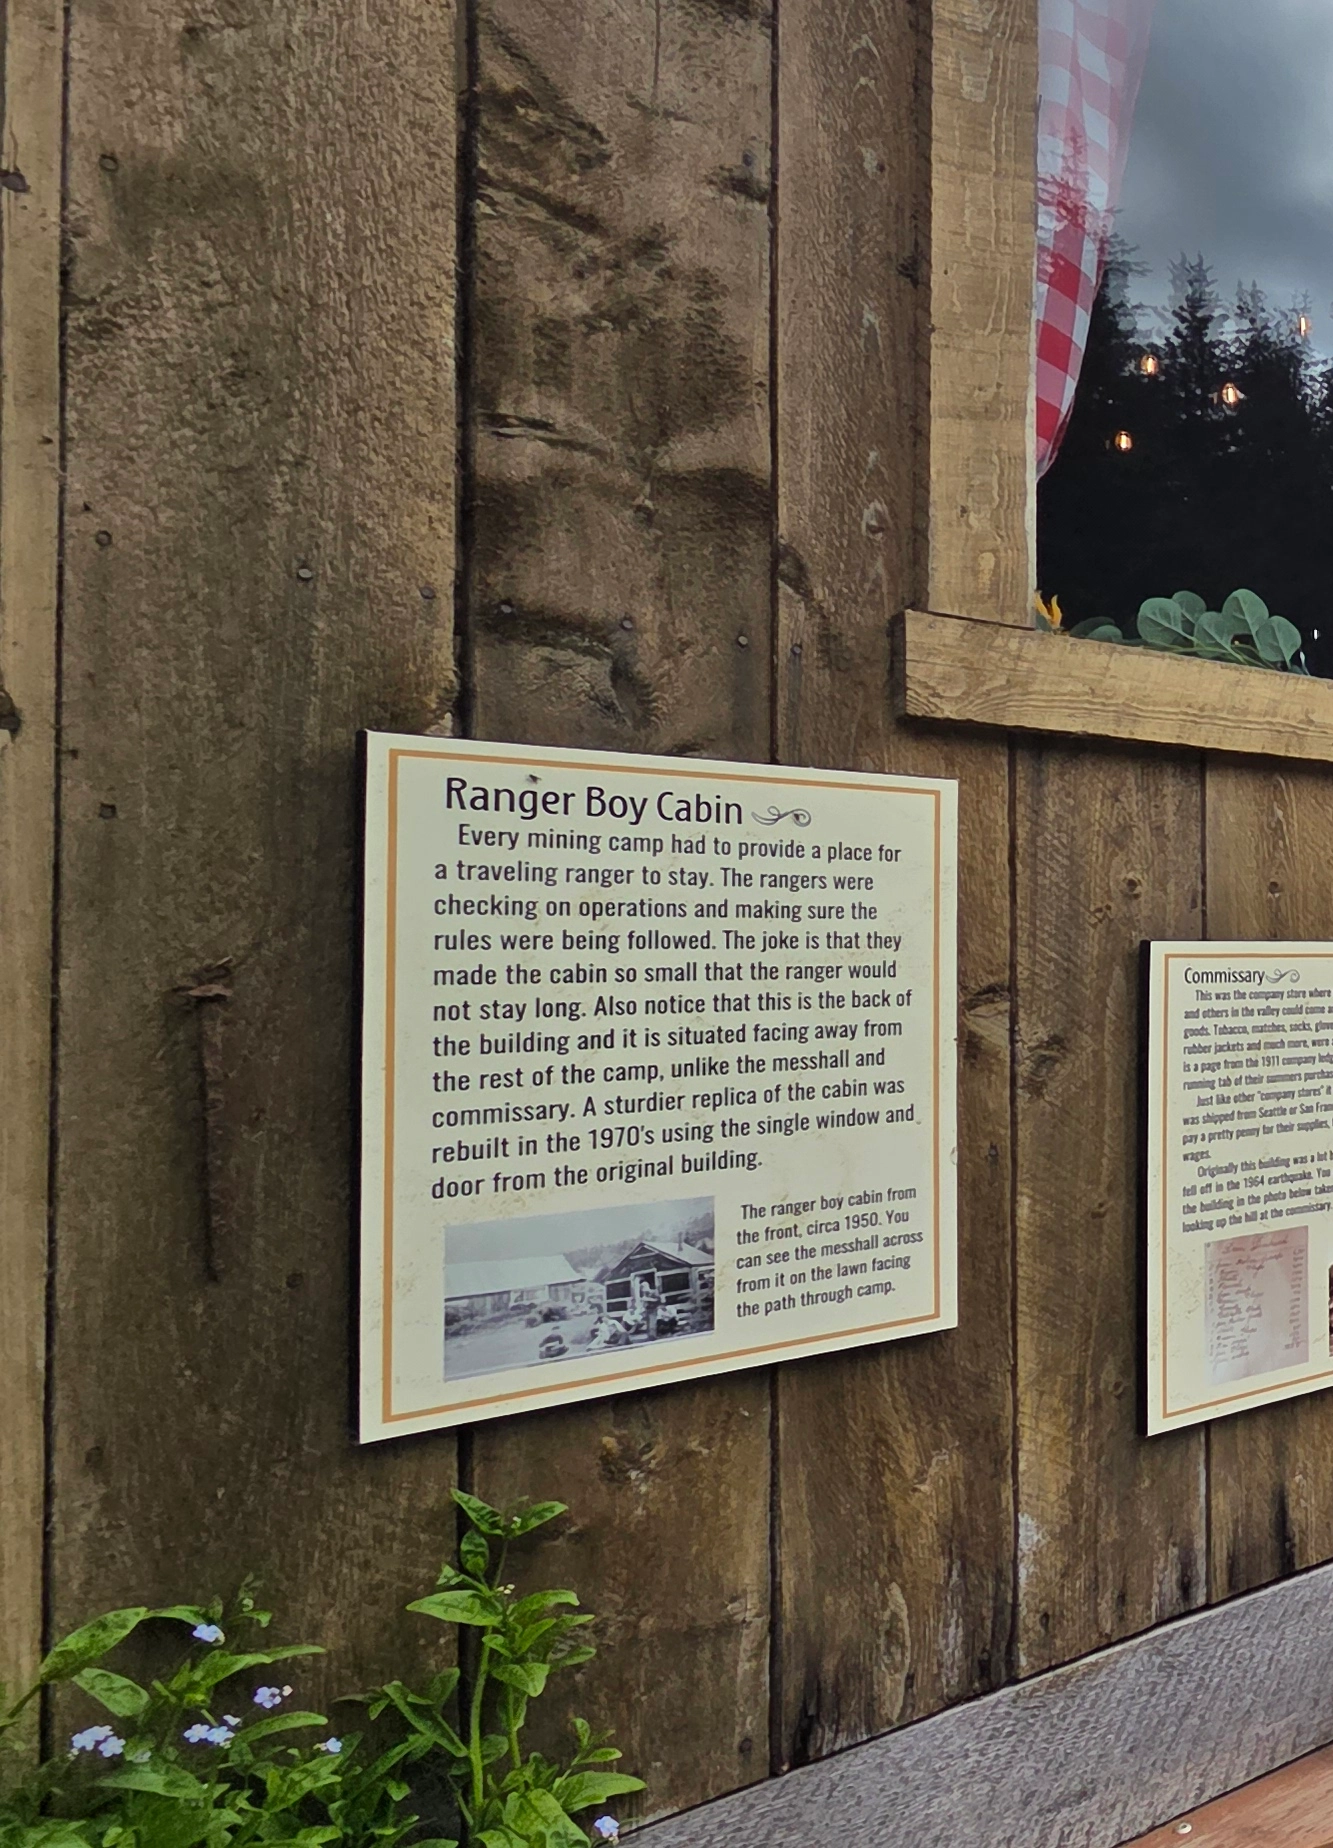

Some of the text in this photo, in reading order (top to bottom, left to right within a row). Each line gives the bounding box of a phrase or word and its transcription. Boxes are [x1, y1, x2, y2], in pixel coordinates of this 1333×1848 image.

[446, 777, 742, 825] Ranger Boy Cabin
[458, 823, 901, 863] Every mining camp had to provide a place for
[434, 860, 873, 892] a traveling ranger to stay. The rangers were
[434, 893, 877, 922] checking on operations and making sure the
[434, 929, 901, 953] rules were being followed. The joke is that they
[434, 959, 896, 985] made the cabin so small that the ranger would
[1184, 967, 1265, 986] Commissary
[433, 989, 912, 1022] not stay long. Also notice that this is the back of
[433, 1019, 902, 1056] the building and it is situated facing away from
[432, 1047, 884, 1092] the rest of the camp, unlike the messhall and
[1182, 1077, 1216, 1090] running
[1217, 1075, 1232, 1087] tab
[1233, 1074, 1243, 1086] of
[1244, 1073, 1264, 1085] their
[432, 1079, 904, 1128] commissary. A sturdier replica of the cabin was
[432, 1103, 914, 1163] rebuilt in the 1970's using the single window and
[431, 1149, 762, 1199] door from the original building.
[1197, 1161, 1238, 1178] Originally
[1240, 1159, 1256, 1171] this
[1258, 1156, 1290, 1169] building
[1292, 1155, 1308, 1165] was
[1309, 1154, 1315, 1163] a
[740, 1187, 916, 1220] The ranger boy cabin from
[736, 1209, 909, 1245] the front, circa 1950. You
[736, 1231, 923, 1269] can see the messhall across
[736, 1254, 910, 1293] from it on the lawn facing
[736, 1281, 895, 1317] the path through camp.
